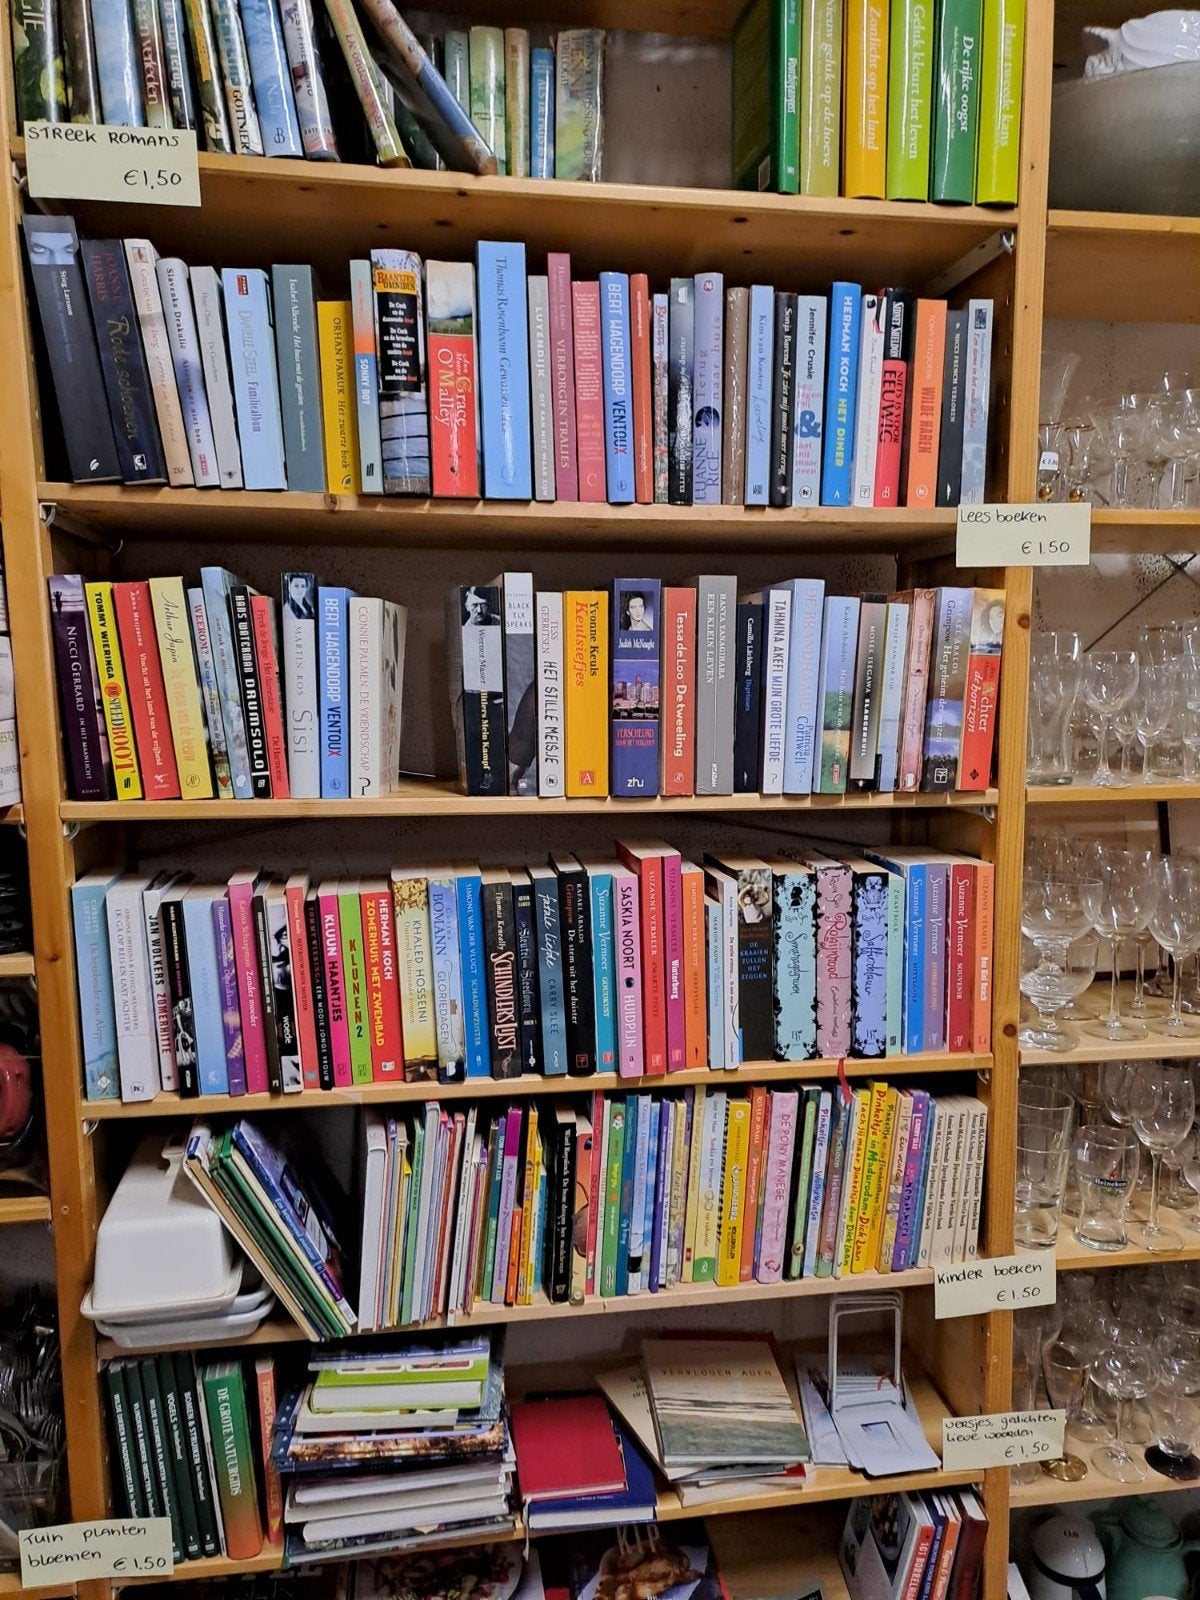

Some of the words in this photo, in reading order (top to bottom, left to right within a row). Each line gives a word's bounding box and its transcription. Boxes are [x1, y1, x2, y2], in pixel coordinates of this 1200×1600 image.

[913, 4, 926, 48] Geluk
[821, 42, 837, 82] geluk
[962, 35, 975, 56] De
[910, 51, 925, 96] kleurt
[960, 59, 973, 92] rijke
[820, 85, 832, 104] op
[910, 99, 923, 121] het
[823, 107, 834, 124] de
[957, 94, 969, 133] oogst
[822, 127, 834, 167] hoeve
[908, 123, 922, 160] leven
[60, 270, 68, 287] Stieg
[63, 289, 74, 316] Larsson
[607, 283, 622, 316] BERT
[890, 300, 905, 327] SIDNEY
[332, 316, 343, 356] ORHAN
[535, 306, 546, 379] LUYENDIJK
[806, 306, 818, 346] Jennifer
[840, 295, 854, 354] HERMAN
[609, 319, 626, 396] WAGENDORP
[889, 327, 904, 359] SHELDON
[335, 358, 347, 397] PAMUK
[359, 358, 370, 387] SONNY
[556, 338, 569, 417] VERBORGEN
[806, 348, 817, 381] Crusie
[839, 357, 851, 393] KOCH
[361, 389, 371, 406] BOY
[455, 376, 473, 427] Grace
[894, 370, 904, 399] NIETS
[920, 386, 936, 418] WILDE
[337, 399, 347, 416] Het
[836, 397, 848, 422] HET
[879, 369, 897, 444] EEUWIG
[894, 400, 902, 411] IS
[338, 418, 349, 448] zwarte
[560, 420, 571, 468] TRALIES
[612, 400, 628, 456] VENTOUX
[892, 413, 902, 444] VOOR
[918, 419, 933, 454] HAREN
[341, 449, 351, 470] boek
[834, 428, 847, 469] DINER
[959, 508, 992, 524] Lees
[995, 508, 1048, 524] boeken
[95, 591, 107, 627] TOMMY
[161, 590, 179, 633] Arthur
[235, 595, 247, 619] HANS
[324, 598, 340, 627] BERT
[589, 602, 599, 642] Yvonne
[773, 601, 787, 643] TAHMINA
[541, 605, 551, 655] GERRITSEN
[550, 619, 559, 641] TESS
[676, 610, 689, 641] Tessa
[99, 630, 116, 680] WIERINGA
[164, 632, 185, 664] Japin
[237, 622, 255, 674] WATERMAN
[573, 600, 589, 688] Keulsiefjes
[590, 645, 600, 677] Keuls
[676, 642, 688, 657] de
[772, 646, 785, 673] AKEFI
[326, 631, 342, 702] WAGENDORP
[543, 660, 559, 682] HET
[676, 659, 688, 680] Loo
[974, 671, 983, 683] de
[480, 690, 491, 719] Hitlers
[544, 686, 559, 722] STILLE
[675, 684, 688, 705] De
[771, 675, 782, 698] MIJN
[244, 678, 266, 771] DRUMSOLO
[769, 700, 782, 730] GROTE
[967, 684, 982, 733] horizon
[979, 683, 997, 733] Achter
[291, 709, 314, 755] Sisi
[327, 706, 343, 758] VENTOUX
[481, 720, 490, 740] Mein
[544, 726, 559, 765] MEISJE
[673, 704, 688, 758] tweeling
[768, 732, 781, 763] LIEFDE
[481, 741, 493, 770] Kampf
[626, 777, 644, 788] zhu
[379, 898, 393, 947] HERMAN
[538, 893, 559, 930] fatale
[595, 886, 611, 929] Suzanne
[620, 886, 634, 927] SASKIA
[149, 915, 161, 935] JAN
[324, 913, 337, 956] KLUUN
[366, 900, 378, 964] ZOMERHUIS
[411, 919, 424, 964] KHALED
[152, 938, 165, 986] WOLKERS
[383, 950, 393, 980] KOCH
[545, 932, 560, 970] liefde
[598, 931, 611, 970] Vermeer
[622, 930, 635, 970] NOORT
[327, 960, 342, 1022] HAANTJES
[371, 966, 380, 988] MET
[490, 950, 515, 1022] SCHINDLERS
[548, 978, 559, 1008] CARRY
[670, 958, 681, 1001] Winterberg
[415, 967, 428, 1024] HOSSEINI
[602, 976, 611, 1018] GOUDKUST
[156, 992, 170, 1054] ZOMERHITTE
[282, 1015, 294, 1044] woede
[372, 991, 384, 1047] ZWEMBAD
[494, 1021, 518, 1052] LIJST
[550, 1011, 559, 1035] SLEE
[623, 994, 637, 1048] HUIDPIJN
[781, 1114, 791, 1129] DE
[778, 1131, 790, 1157] PONY
[774, 1160, 788, 1202] MANEGE
[167, 1392, 178, 1425] VOGELS
[215, 1387, 228, 1404] DE
[218, 1404, 233, 1438] GROTE
[224, 1436, 242, 1498] NATUURGIDS
[23, 1532, 64, 1546] Tuin
[83, 1524, 147, 1543] planten
[28, 1549, 102, 1568] bloemen
